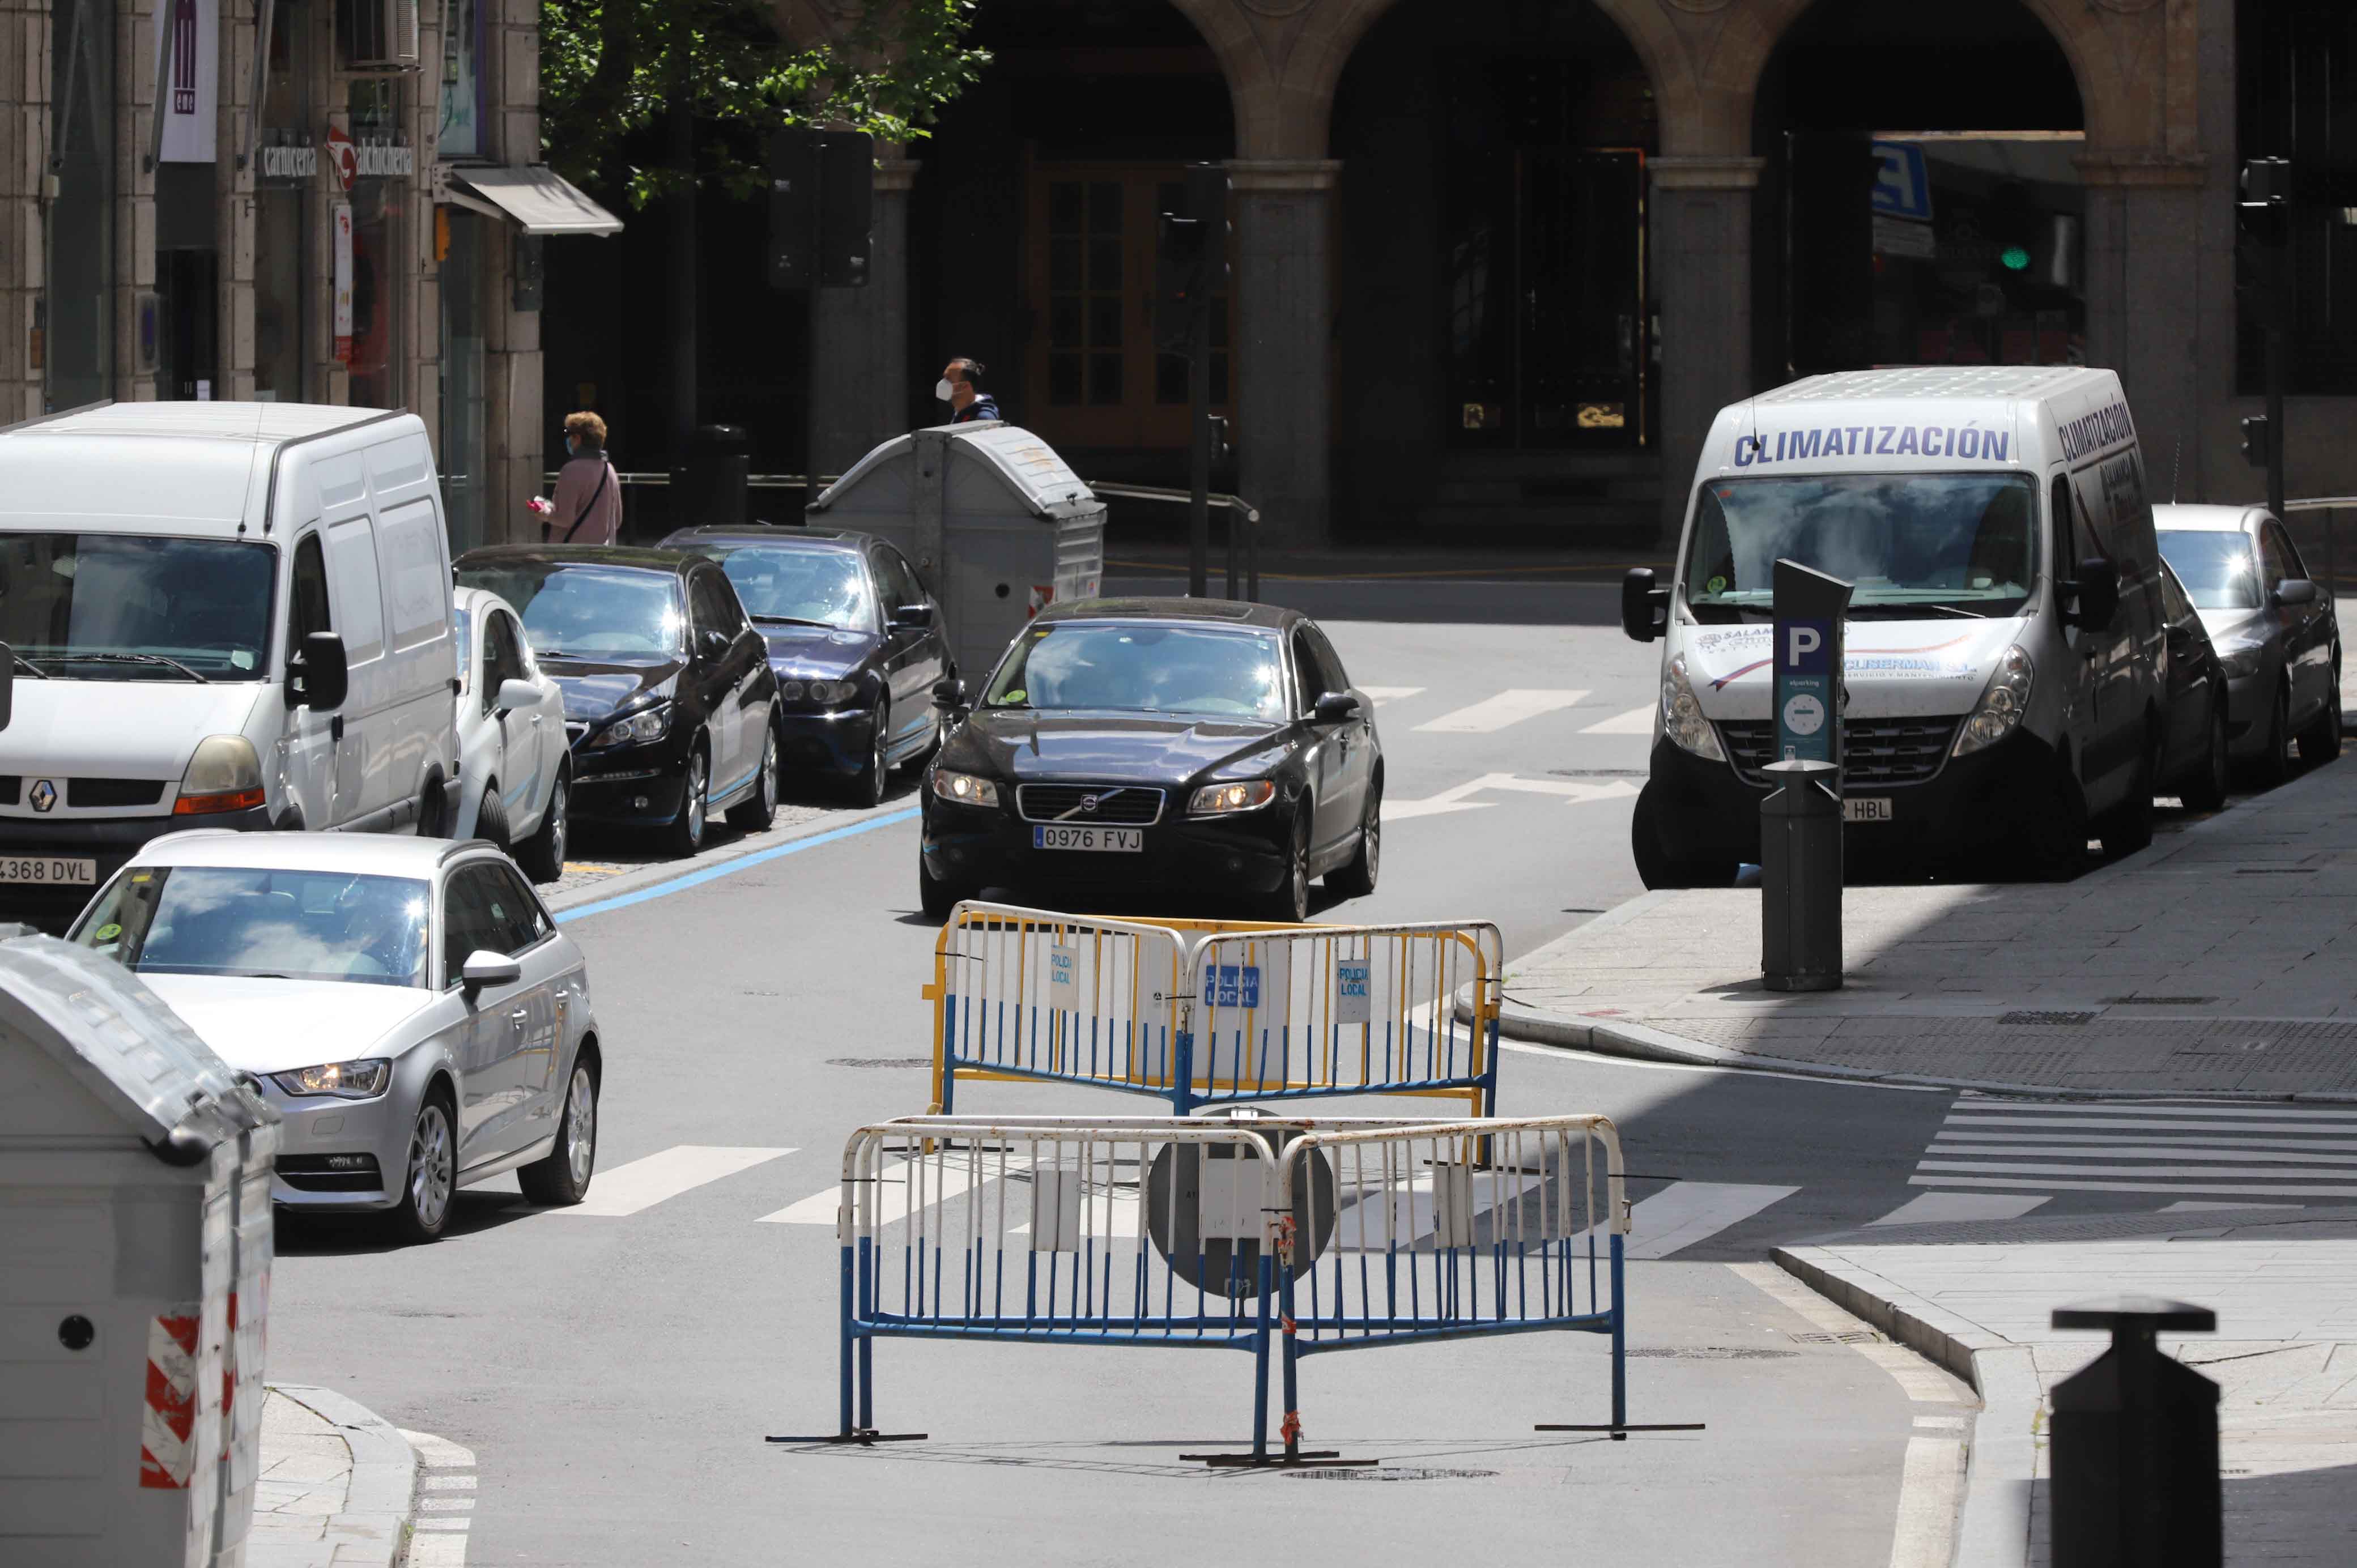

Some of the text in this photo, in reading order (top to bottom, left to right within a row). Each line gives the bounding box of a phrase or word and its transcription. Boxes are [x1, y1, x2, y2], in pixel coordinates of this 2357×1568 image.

[176, 93, 193, 110] eme
[1734, 420, 2009, 467] CLIMATIZACIÓN
[1723, 628, 1773, 640] SALAM
[1789, 627, 1821, 667] P
[1854, 802, 1889, 819] HBL
[1046, 829, 1139, 849] 0976 FVJ
[53, 862, 90, 881] DVL
[1341, 983, 1367, 997] LOCAL
